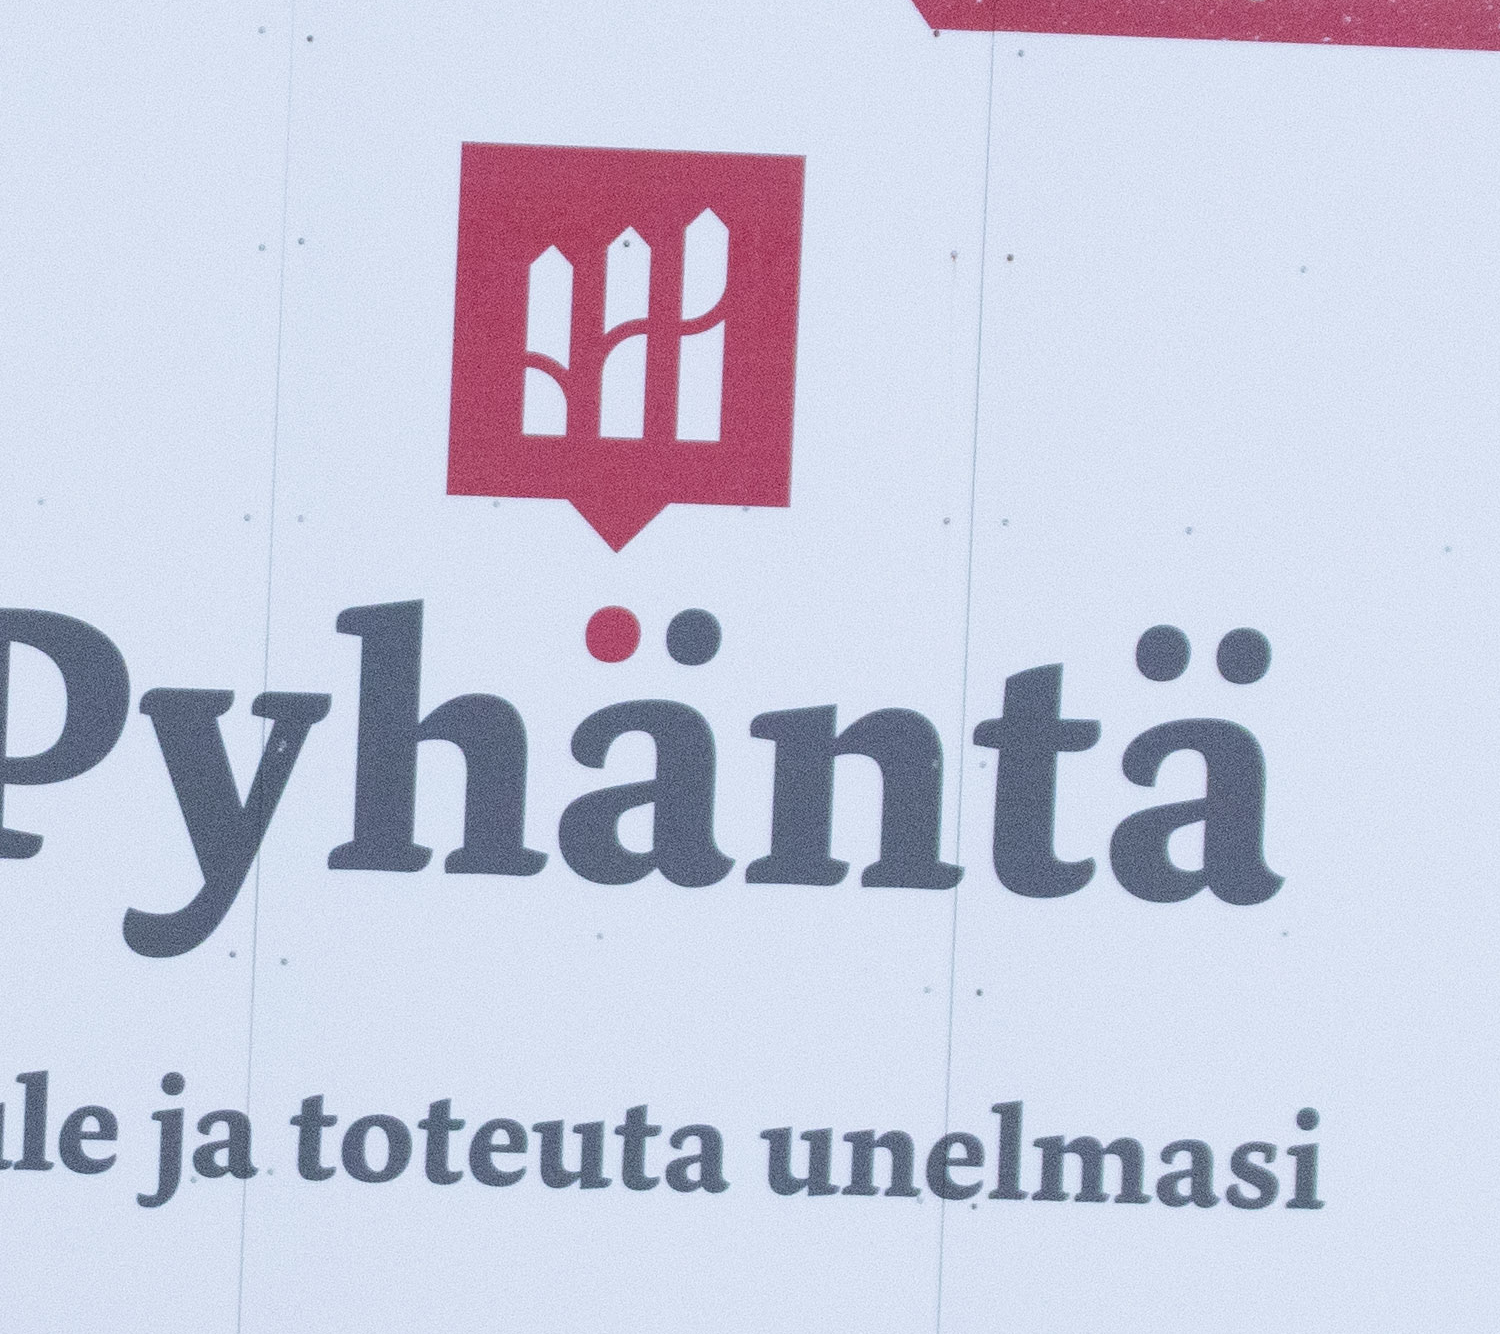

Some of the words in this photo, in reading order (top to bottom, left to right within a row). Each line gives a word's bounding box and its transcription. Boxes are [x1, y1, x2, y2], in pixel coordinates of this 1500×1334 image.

[137, 1072, 256, 1208] ja
[291, 1095, 727, 1193] toteuta
[761, 1102, 1322, 1210] unelmasi
